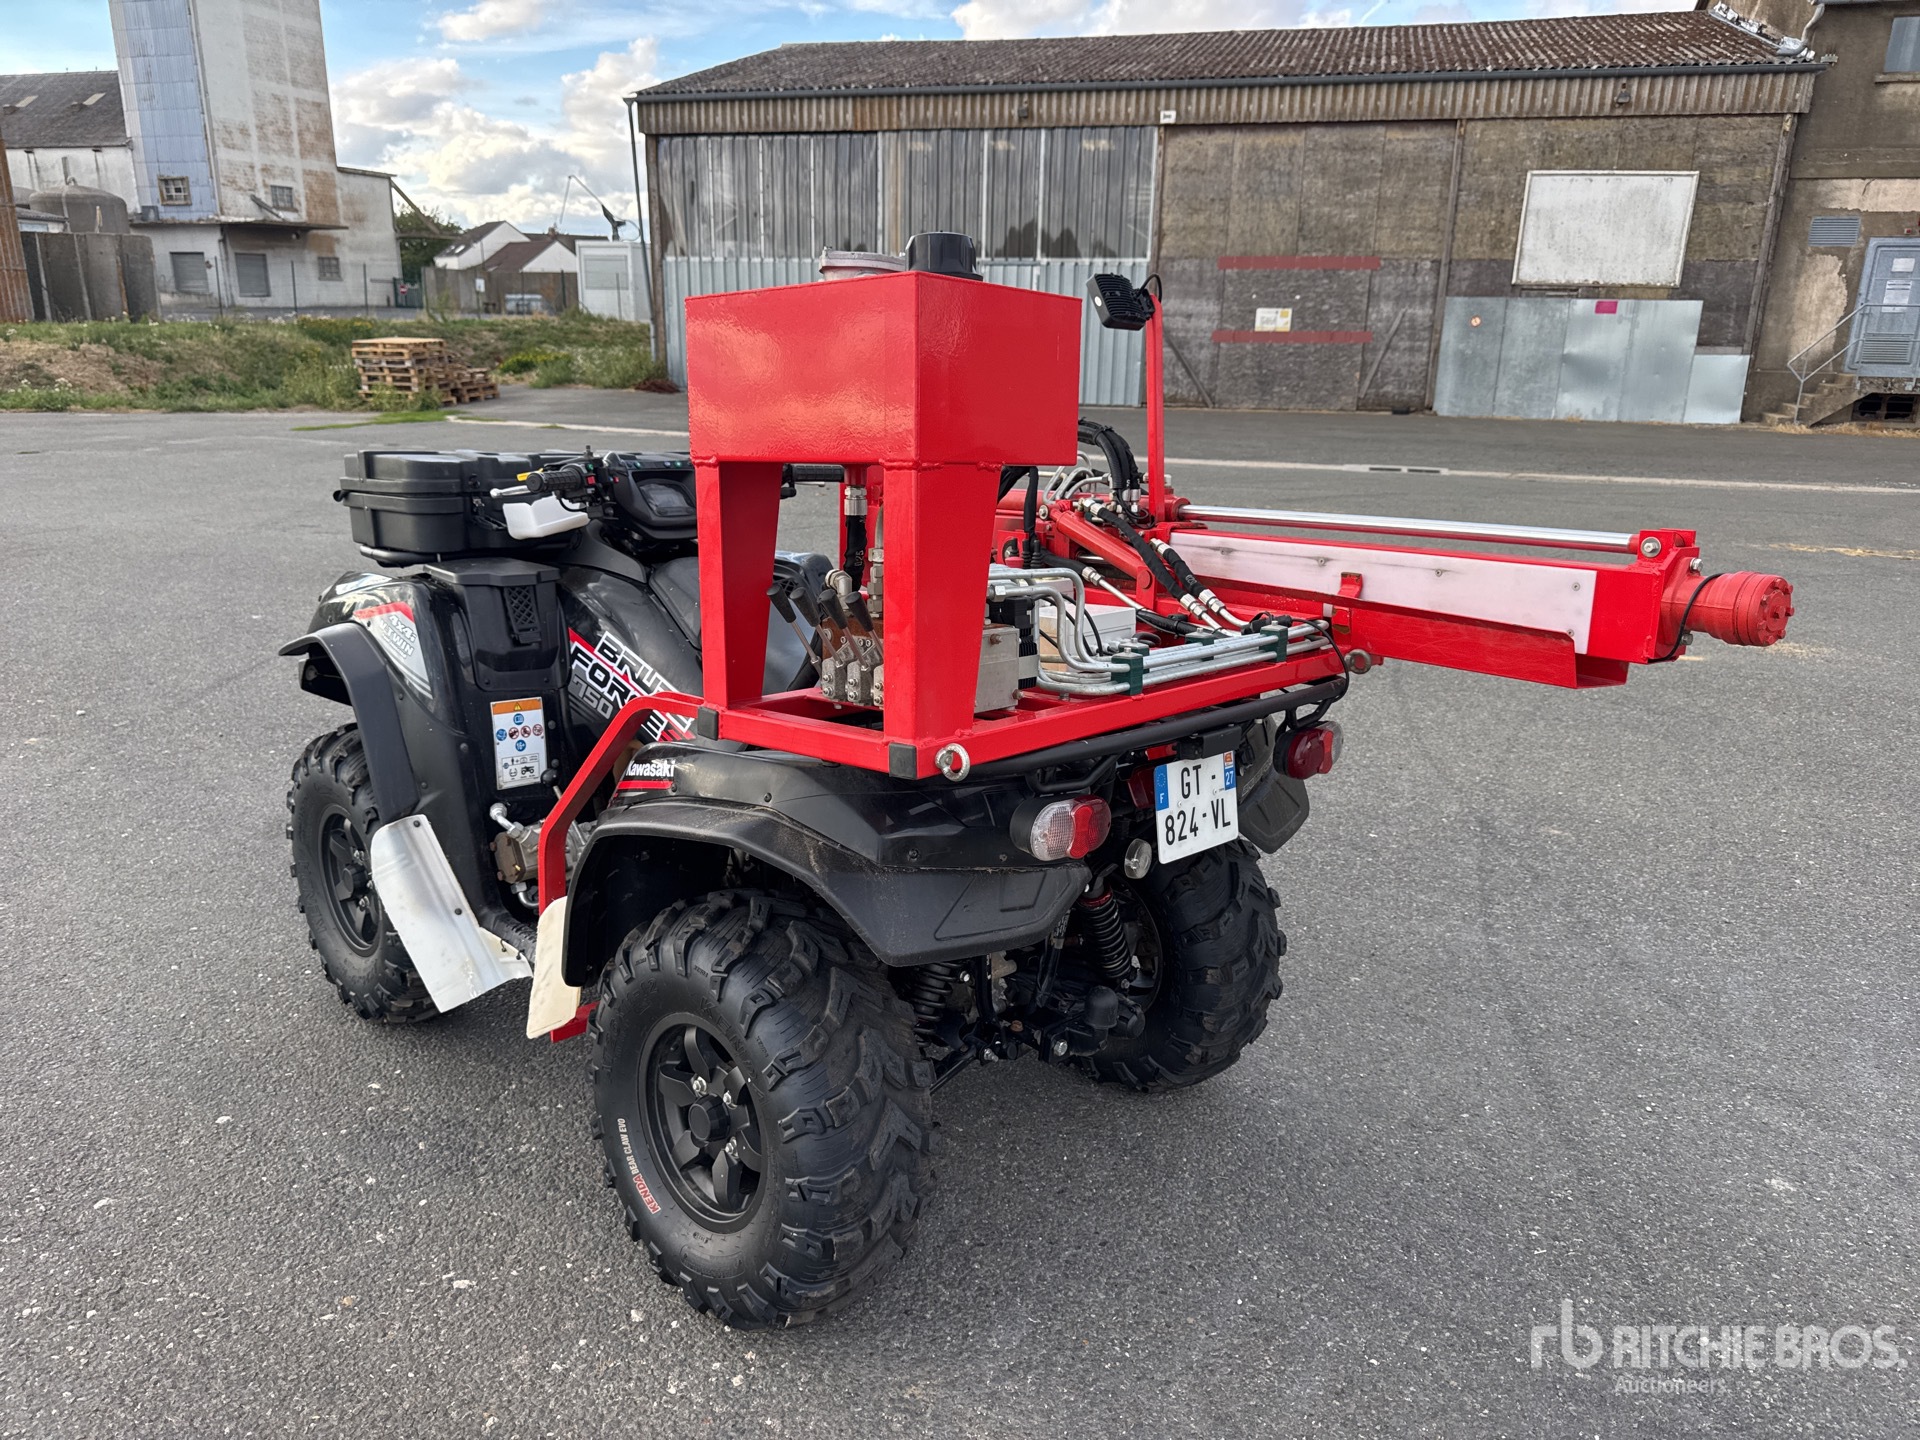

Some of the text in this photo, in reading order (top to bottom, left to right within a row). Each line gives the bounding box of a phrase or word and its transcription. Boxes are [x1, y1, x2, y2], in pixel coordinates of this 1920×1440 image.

[572, 675, 614, 720] 750
[626, 759, 676, 778] Kawasaki
[1226, 771, 1234, 786] 27
[1159, 792, 1165, 804] F
[616, 1117, 662, 1214] KENDA BEAR CLAW EVO
